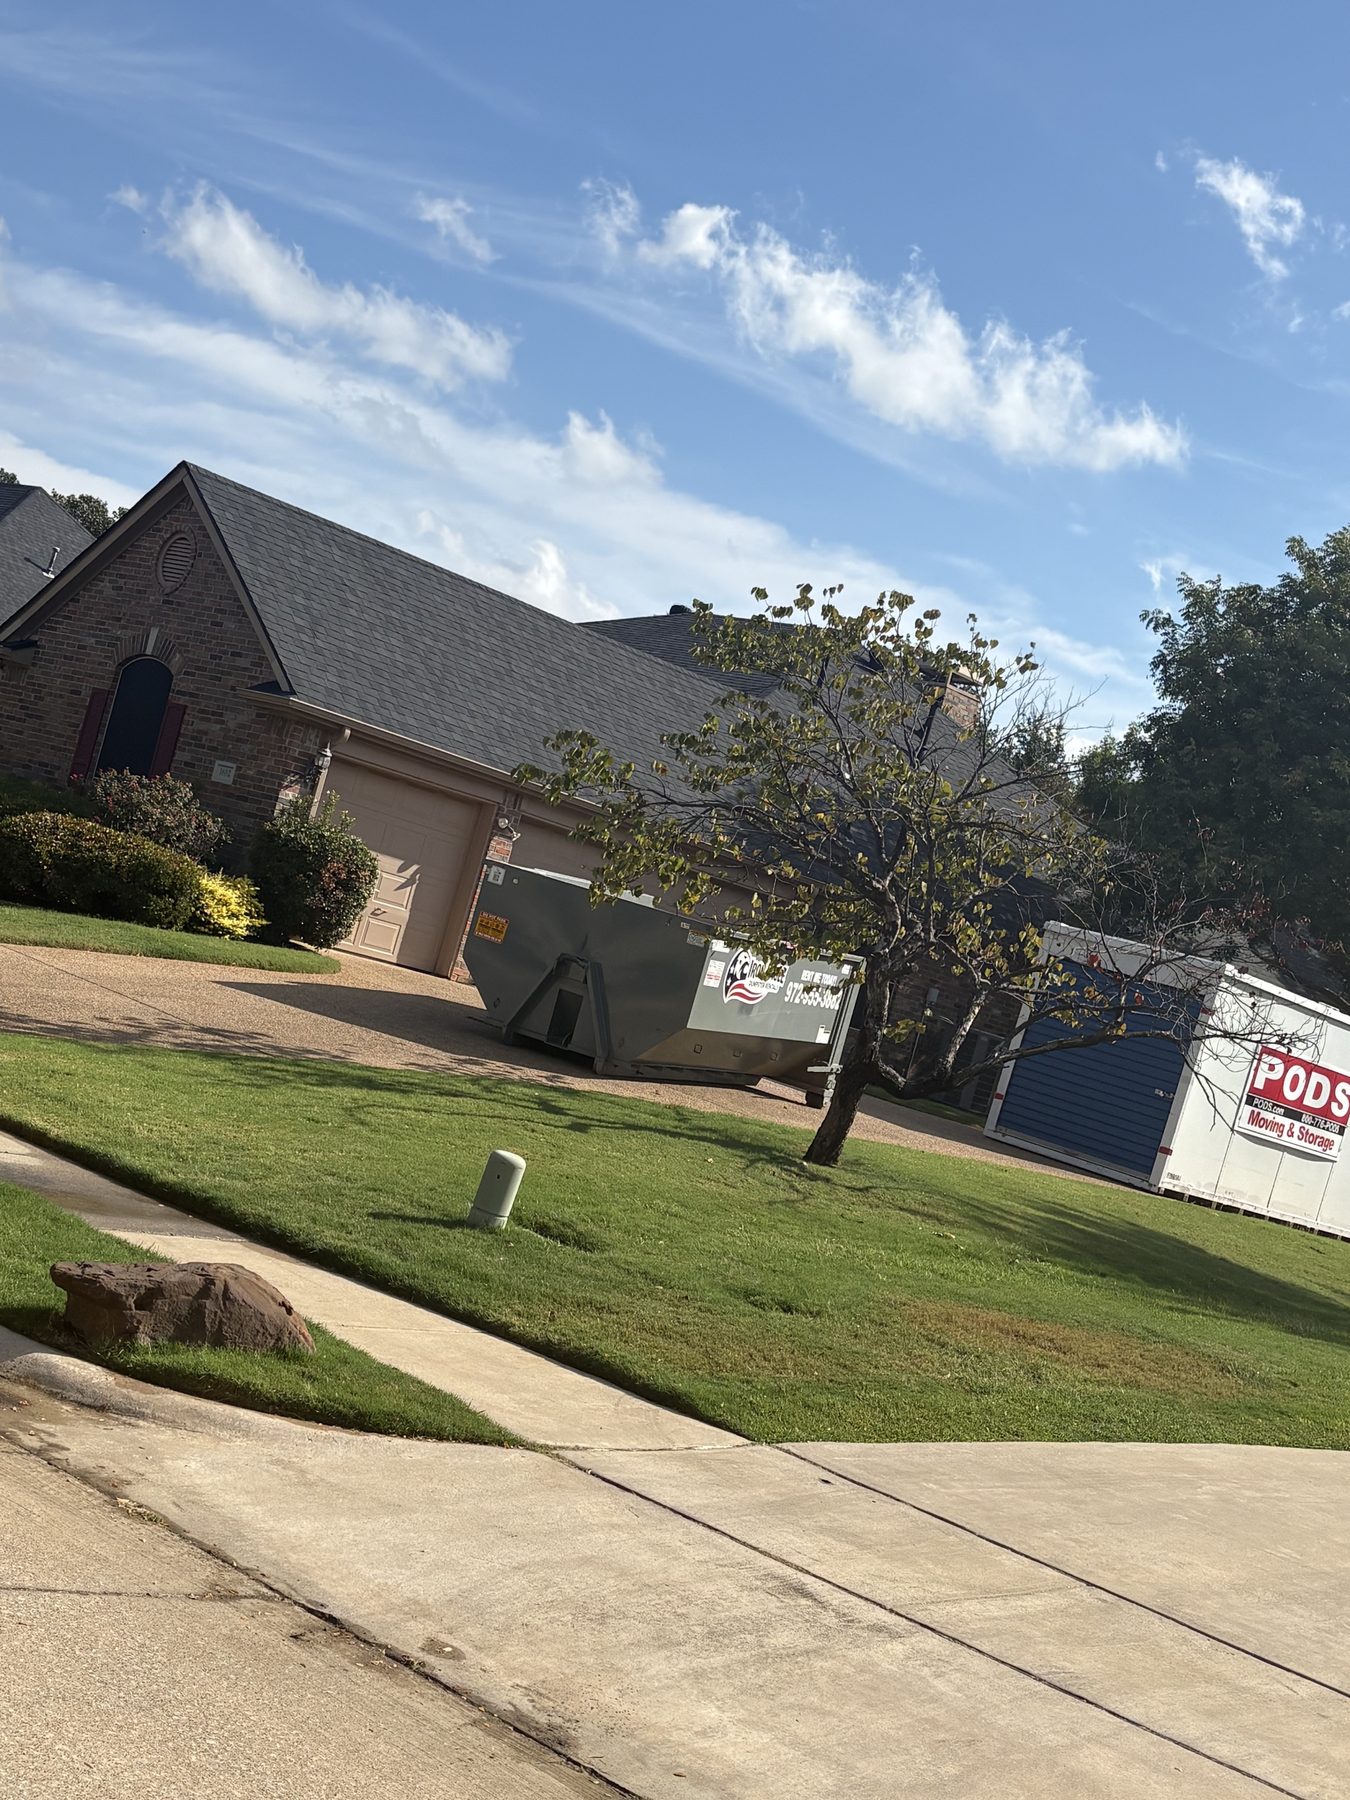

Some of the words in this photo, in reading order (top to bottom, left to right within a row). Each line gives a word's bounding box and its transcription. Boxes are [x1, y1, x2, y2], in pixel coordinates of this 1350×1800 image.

[1252, 1098, 1285, 1115] PODS.com
[1253, 1053, 1350, 1118] PODS
[1247, 1109, 1285, 1138] Moving
[1286, 1122, 1295, 1138] &
[1297, 1125, 1335, 1152] Storage
